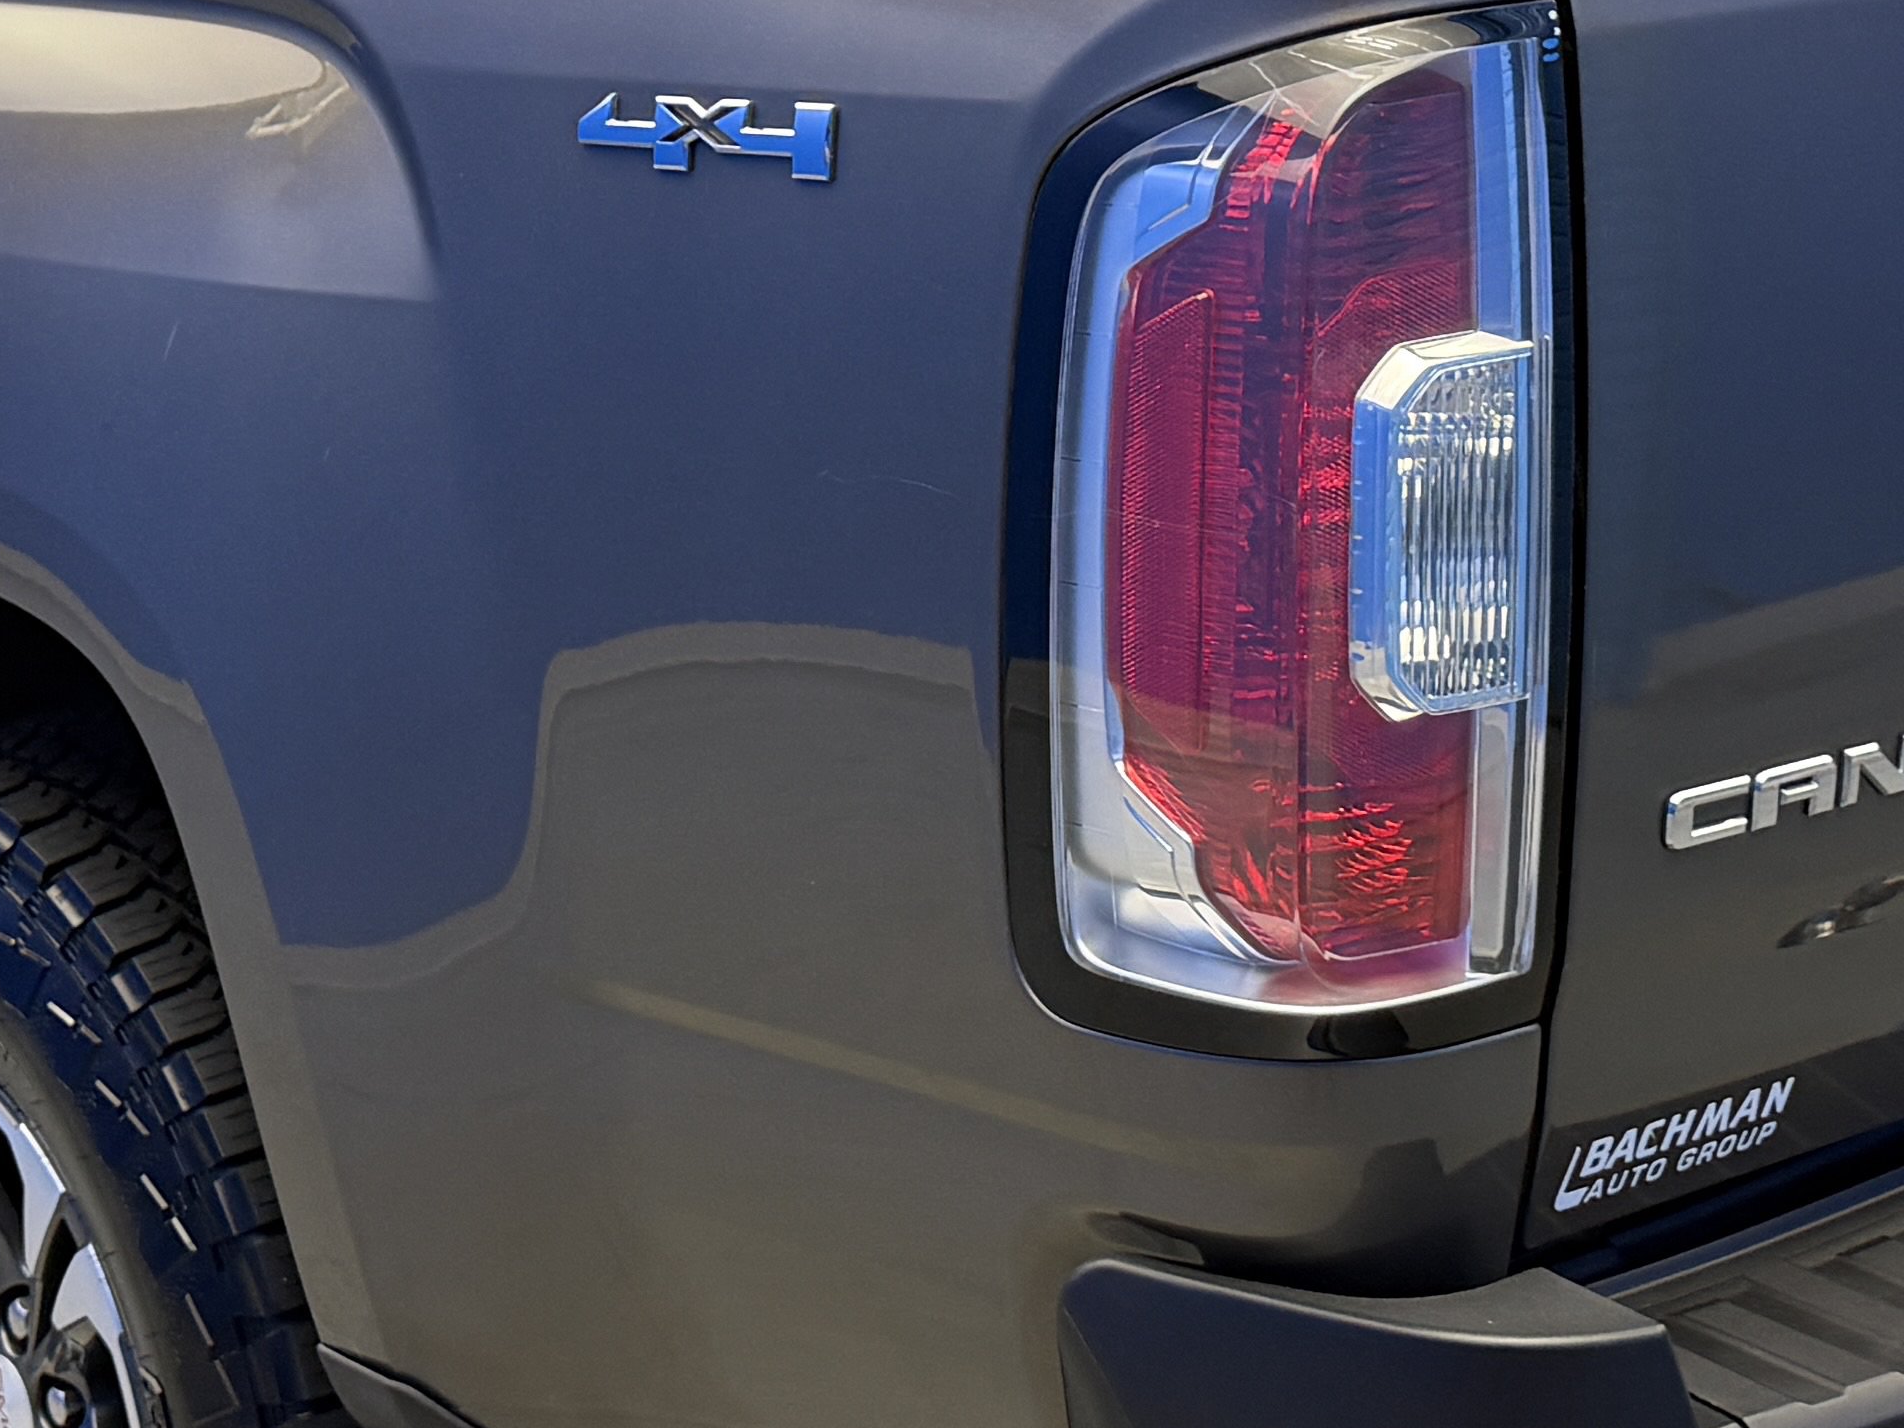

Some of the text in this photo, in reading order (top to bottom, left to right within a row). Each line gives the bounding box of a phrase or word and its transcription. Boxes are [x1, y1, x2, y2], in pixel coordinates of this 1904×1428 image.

[1580, 1076, 1795, 1178] BACHMAN
[1582, 1120, 1778, 1205] AUTO GROUP
